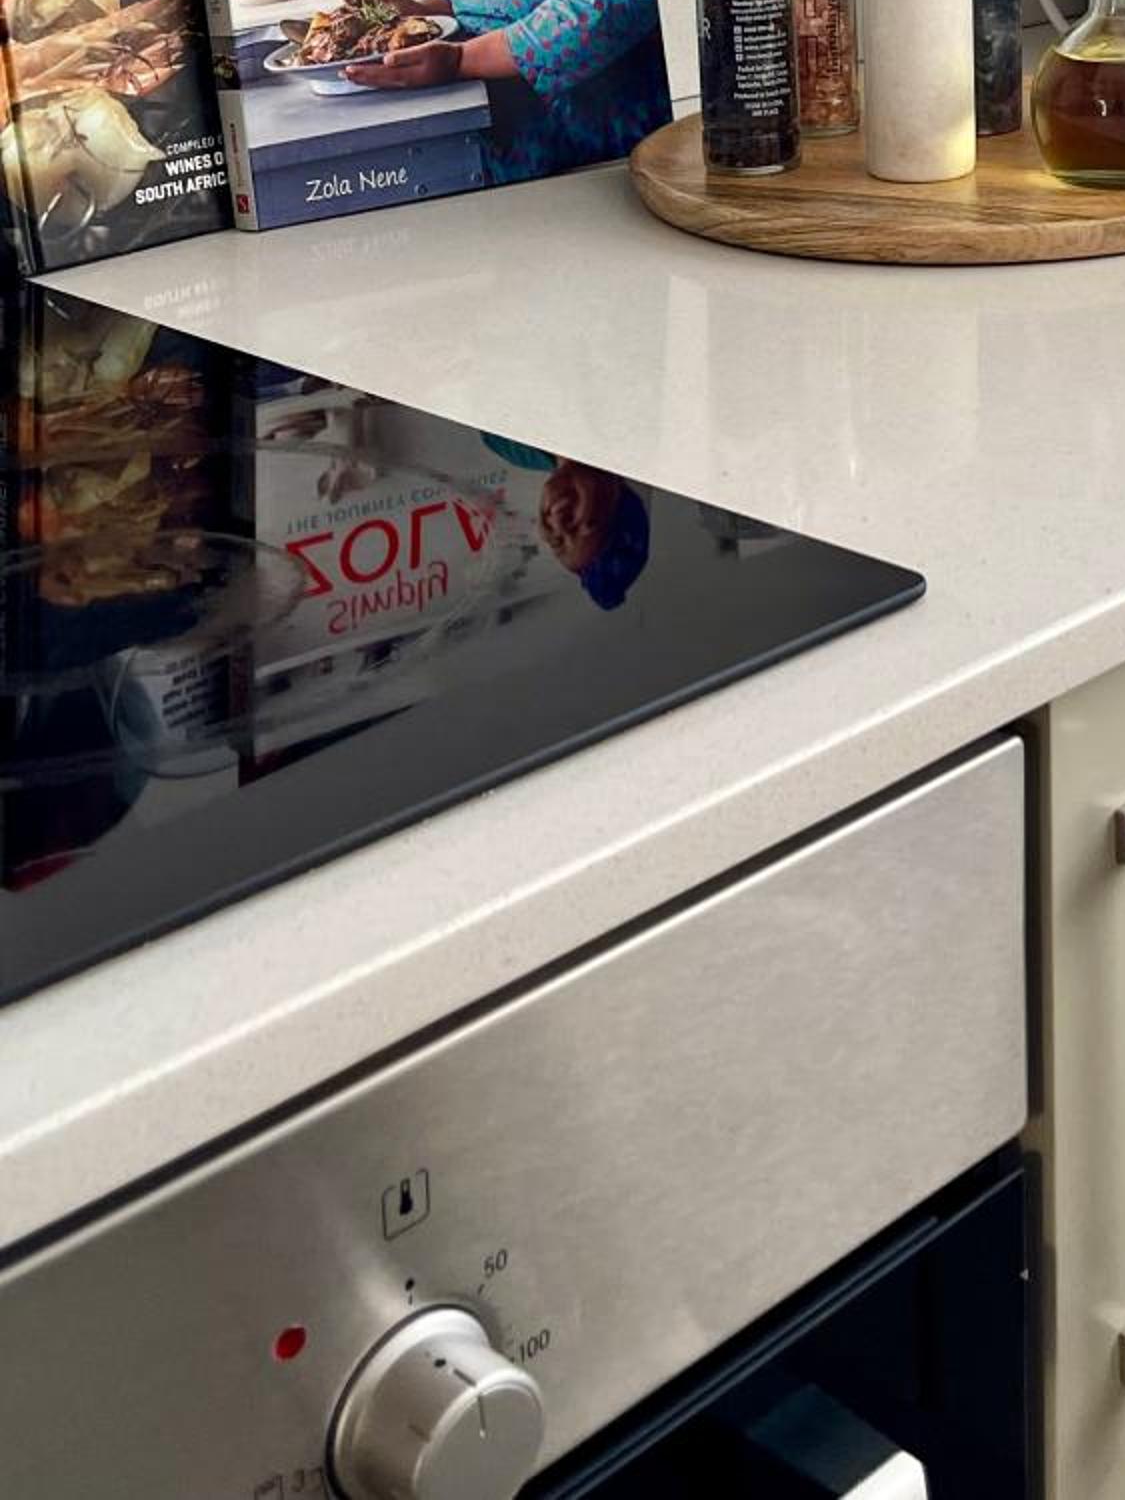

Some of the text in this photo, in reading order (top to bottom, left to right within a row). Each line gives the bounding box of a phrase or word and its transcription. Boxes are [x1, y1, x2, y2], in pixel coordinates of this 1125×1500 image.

[166, 136, 215, 156] COMPILED
[165, 151, 225, 177] WINES O
[135, 171, 227, 205] SOUTH AFRIC
[304, 167, 409, 202] Zola Nene
[483, 1249, 508, 1278] 50
[519, 1329, 550, 1364] 100
